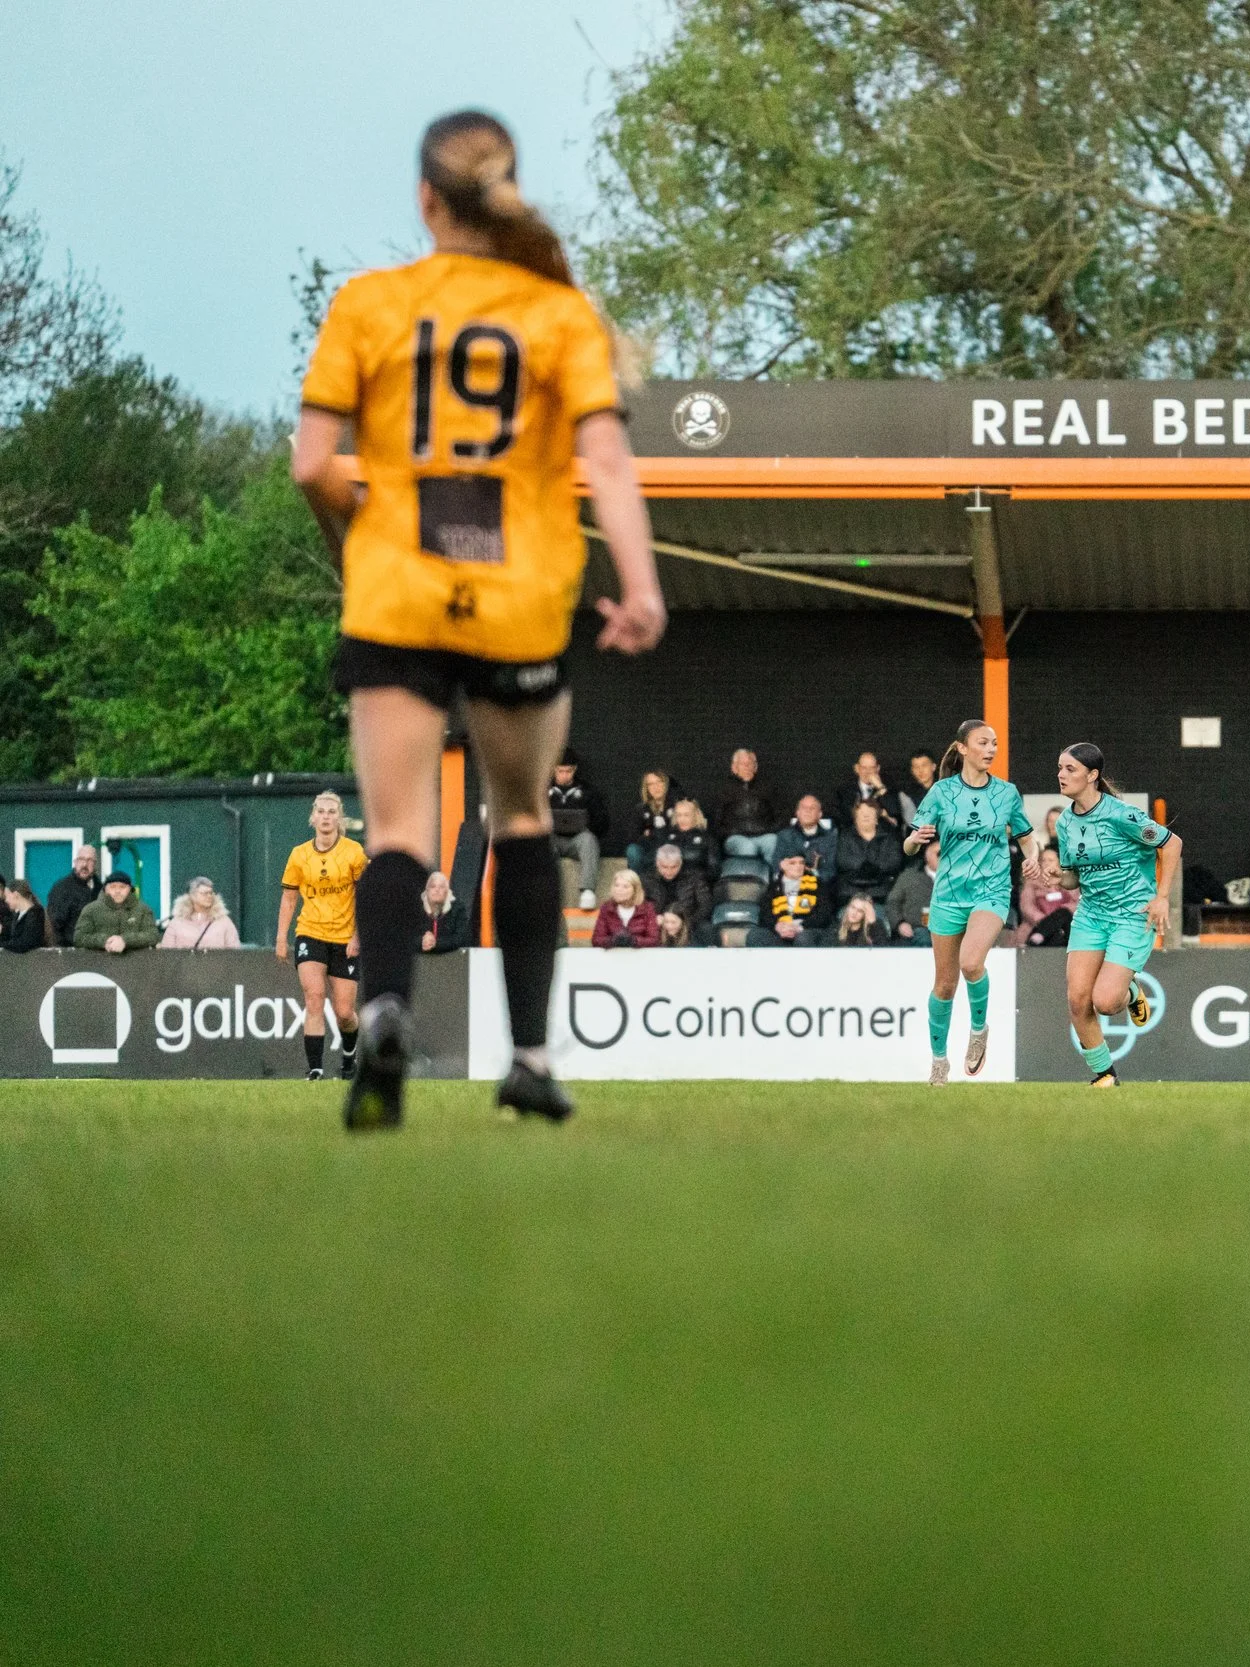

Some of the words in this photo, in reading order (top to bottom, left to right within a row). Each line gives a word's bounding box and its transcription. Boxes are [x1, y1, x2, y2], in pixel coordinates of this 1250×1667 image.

[413, 319, 519, 458] 19
[972, 399, 1127, 445] REAL
[642, 996, 917, 1038] CoinCorner
